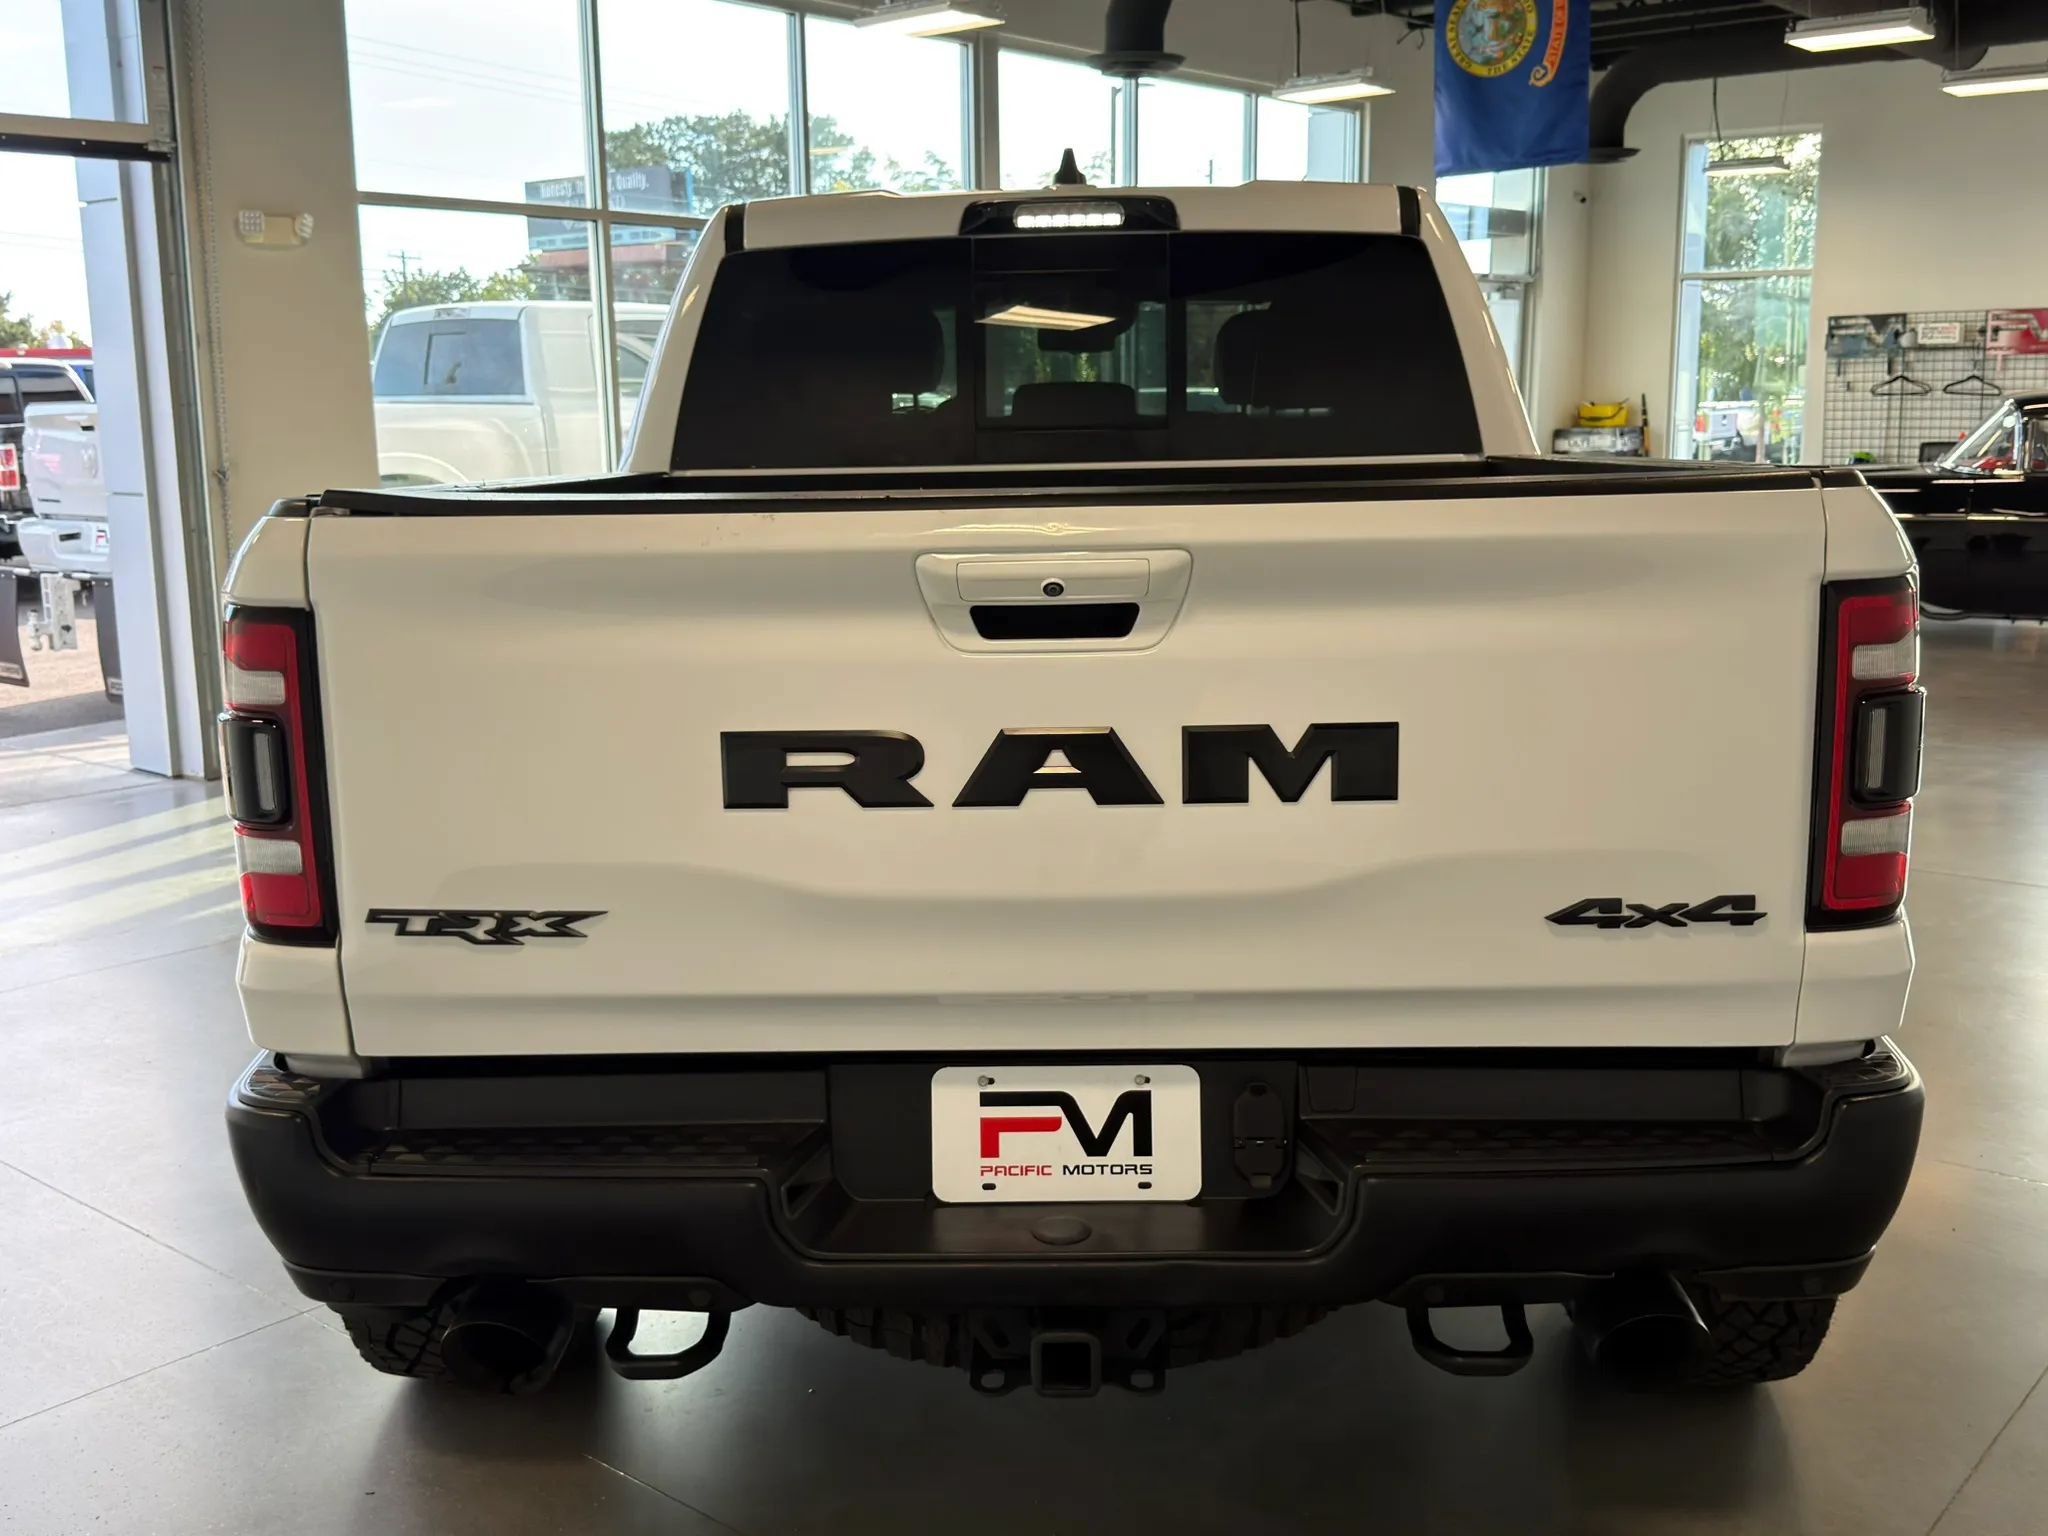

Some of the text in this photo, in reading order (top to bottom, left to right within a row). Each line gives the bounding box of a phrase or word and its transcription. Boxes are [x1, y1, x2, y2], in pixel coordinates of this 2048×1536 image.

[616, 171, 650, 191] Quality.
[720, 721, 1399, 808] RAM
[365, 908, 608, 945] TRX
[1544, 894, 1768, 928] 4x4
[980, 1164, 1153, 1176] PACIFIC MOTORS
